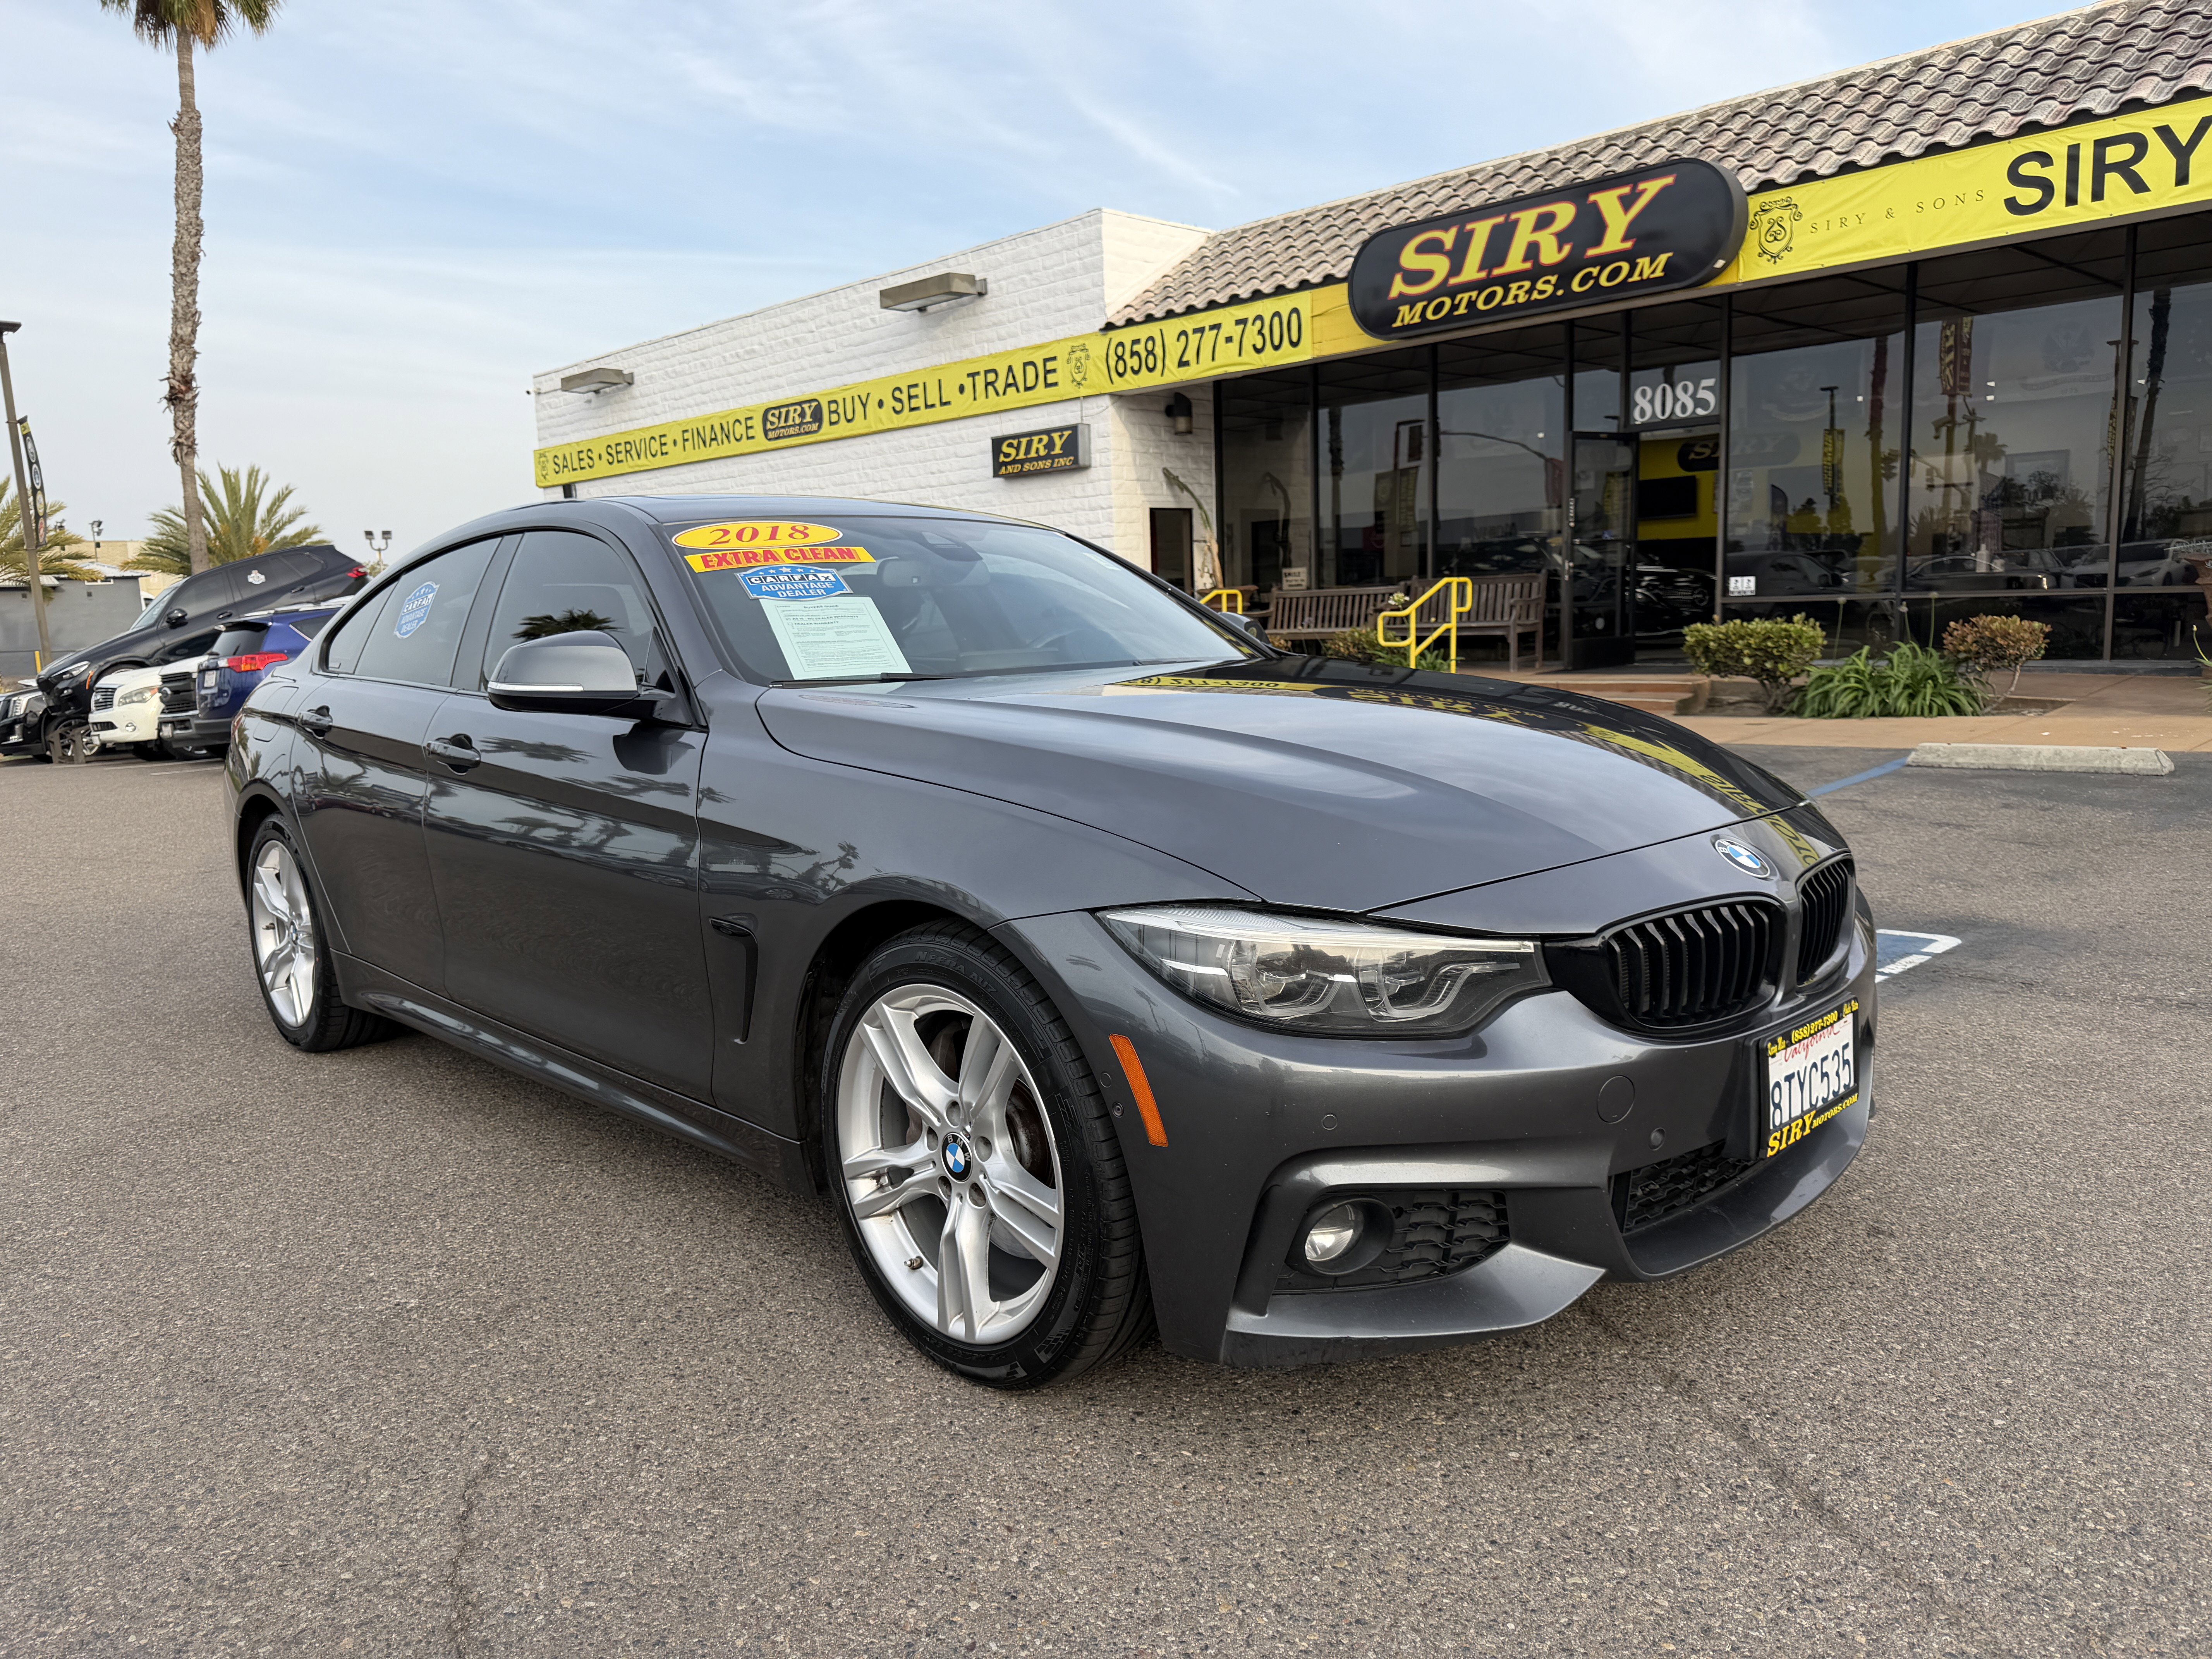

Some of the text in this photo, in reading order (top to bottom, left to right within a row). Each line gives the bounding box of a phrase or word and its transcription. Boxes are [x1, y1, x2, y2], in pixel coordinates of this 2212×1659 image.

[2003, 115, 2212, 216] SIRY
[1810, 189, 1986, 234] SIRY & SONS
[1388, 173, 1677, 301] SIRY
[1105, 307, 1302, 385] (858) 277-7300
[828, 356, 1058, 427] BUY SELL TRADE
[1633, 378, 1716, 422] 8085
[765, 402, 818, 431] SIRY
[767, 422, 819, 439] MOTORS.COM
[553, 416, 755, 474] SALES SERVICE FINANCE
[998, 429, 1072, 463] SIRY
[998, 456, 1074, 475] AND SONS INC
[708, 525, 810, 546] 2018
[701, 547, 859, 569] EXTRA CLEAN
[749, 573, 836, 584] CARFAX
[761, 582, 835, 592] ADVANTAGE
[778, 588, 826, 598] DEALER
[404, 594, 433, 613] CARFAX
[1771, 1042, 1854, 1129] 8TYC535
[1767, 1093, 1858, 1158] SIRY MOTORS.COM
[947, 1135, 971, 1161] BMW
